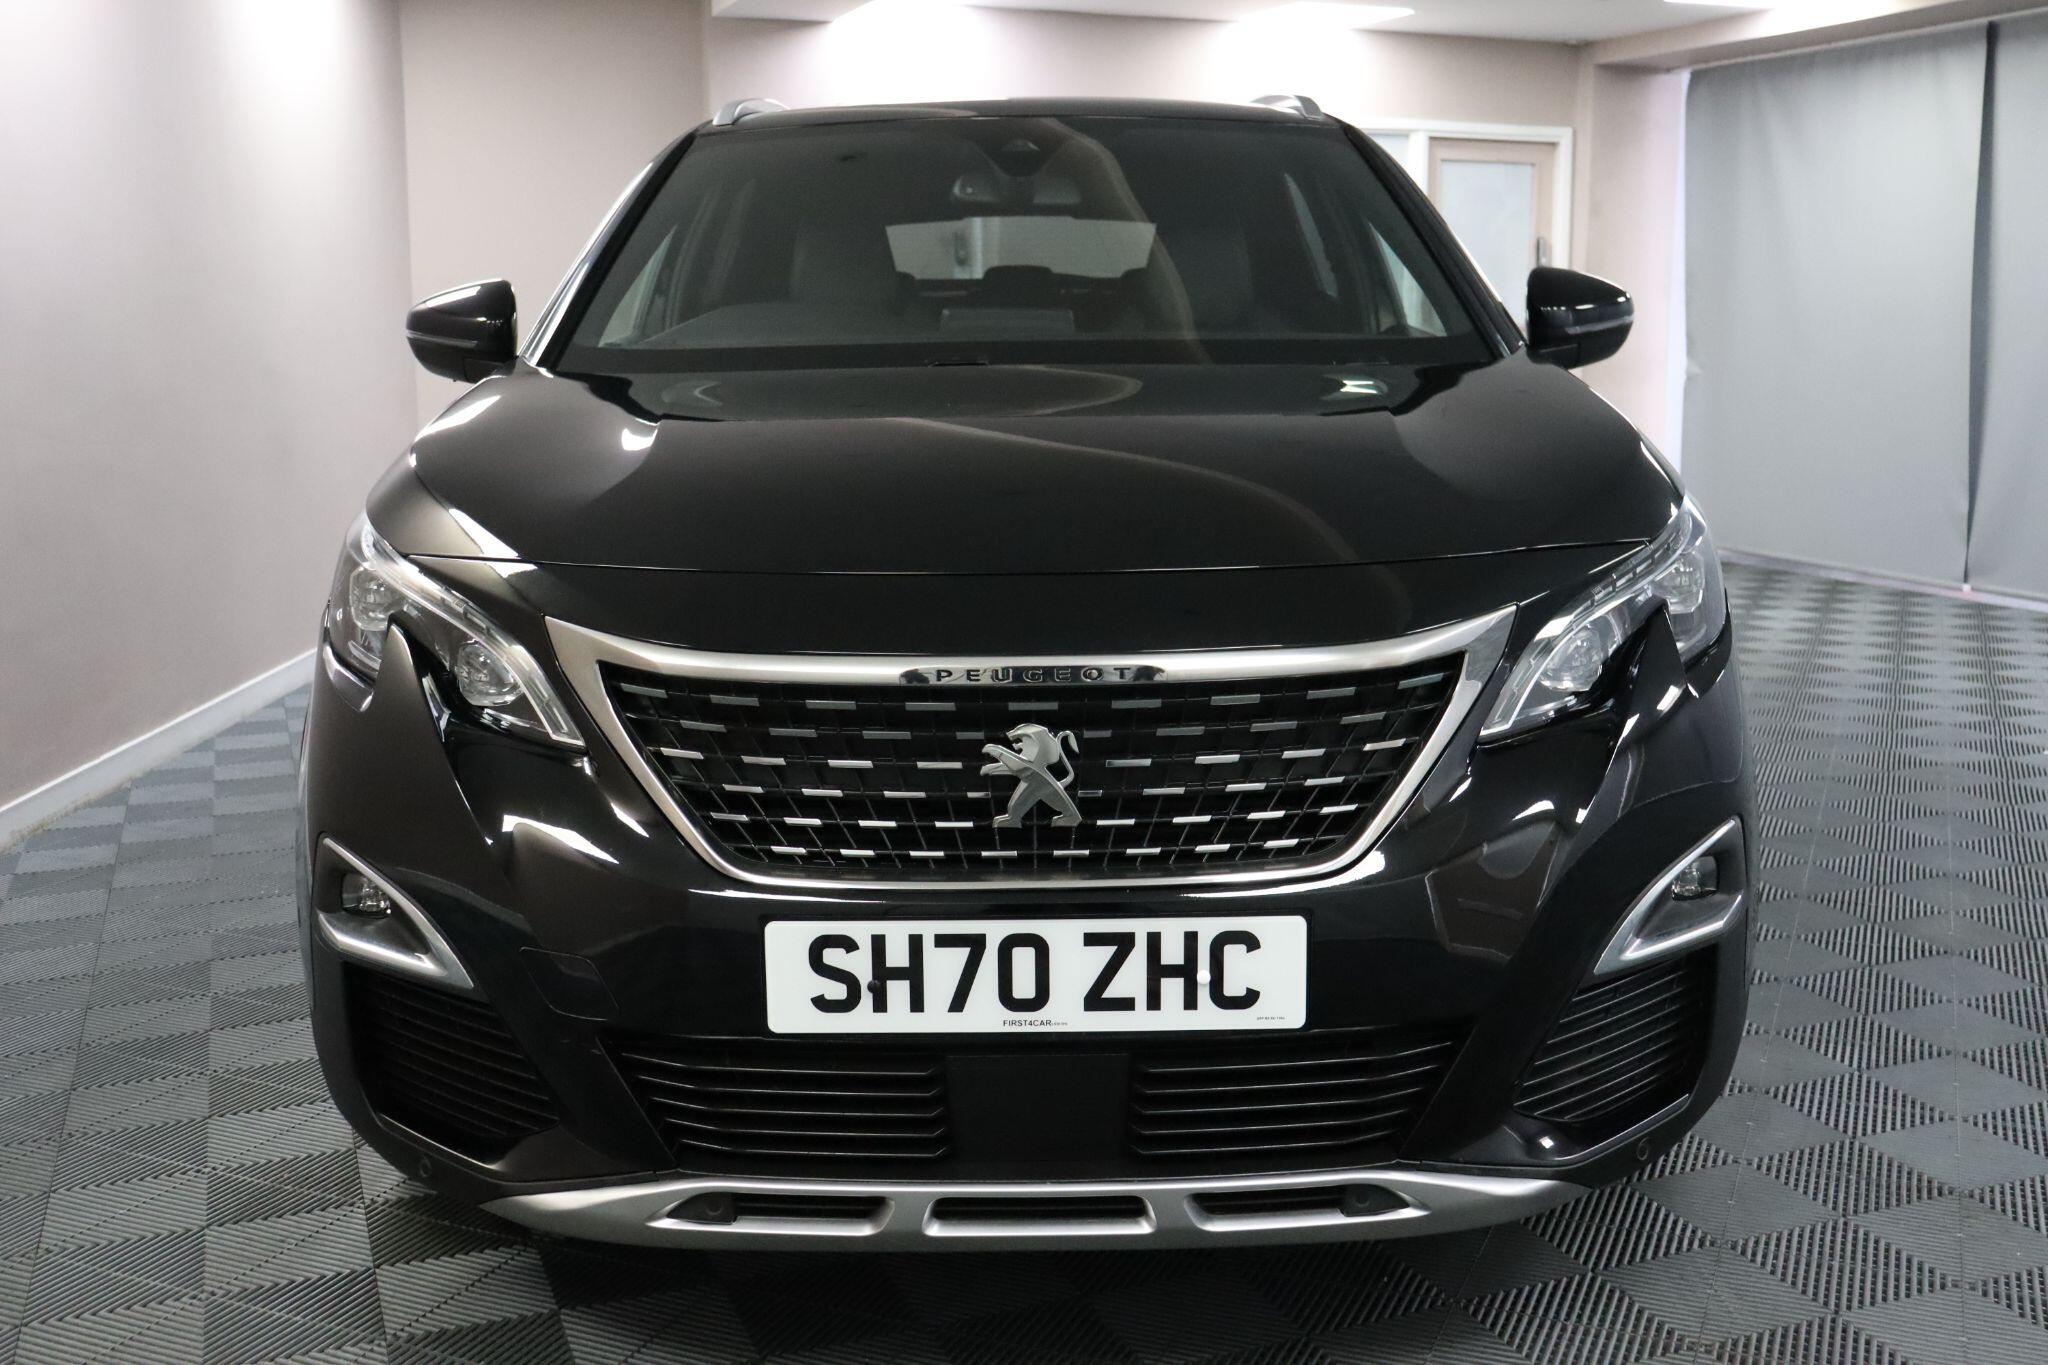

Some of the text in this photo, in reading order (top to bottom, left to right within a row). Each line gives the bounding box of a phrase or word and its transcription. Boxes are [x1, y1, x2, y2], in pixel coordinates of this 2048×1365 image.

[935, 667, 1131, 683] PEUGEOT
[808, 930, 1262, 1014] SH70 ZHC
[1003, 1019, 1052, 1027] FIRST4CAR
